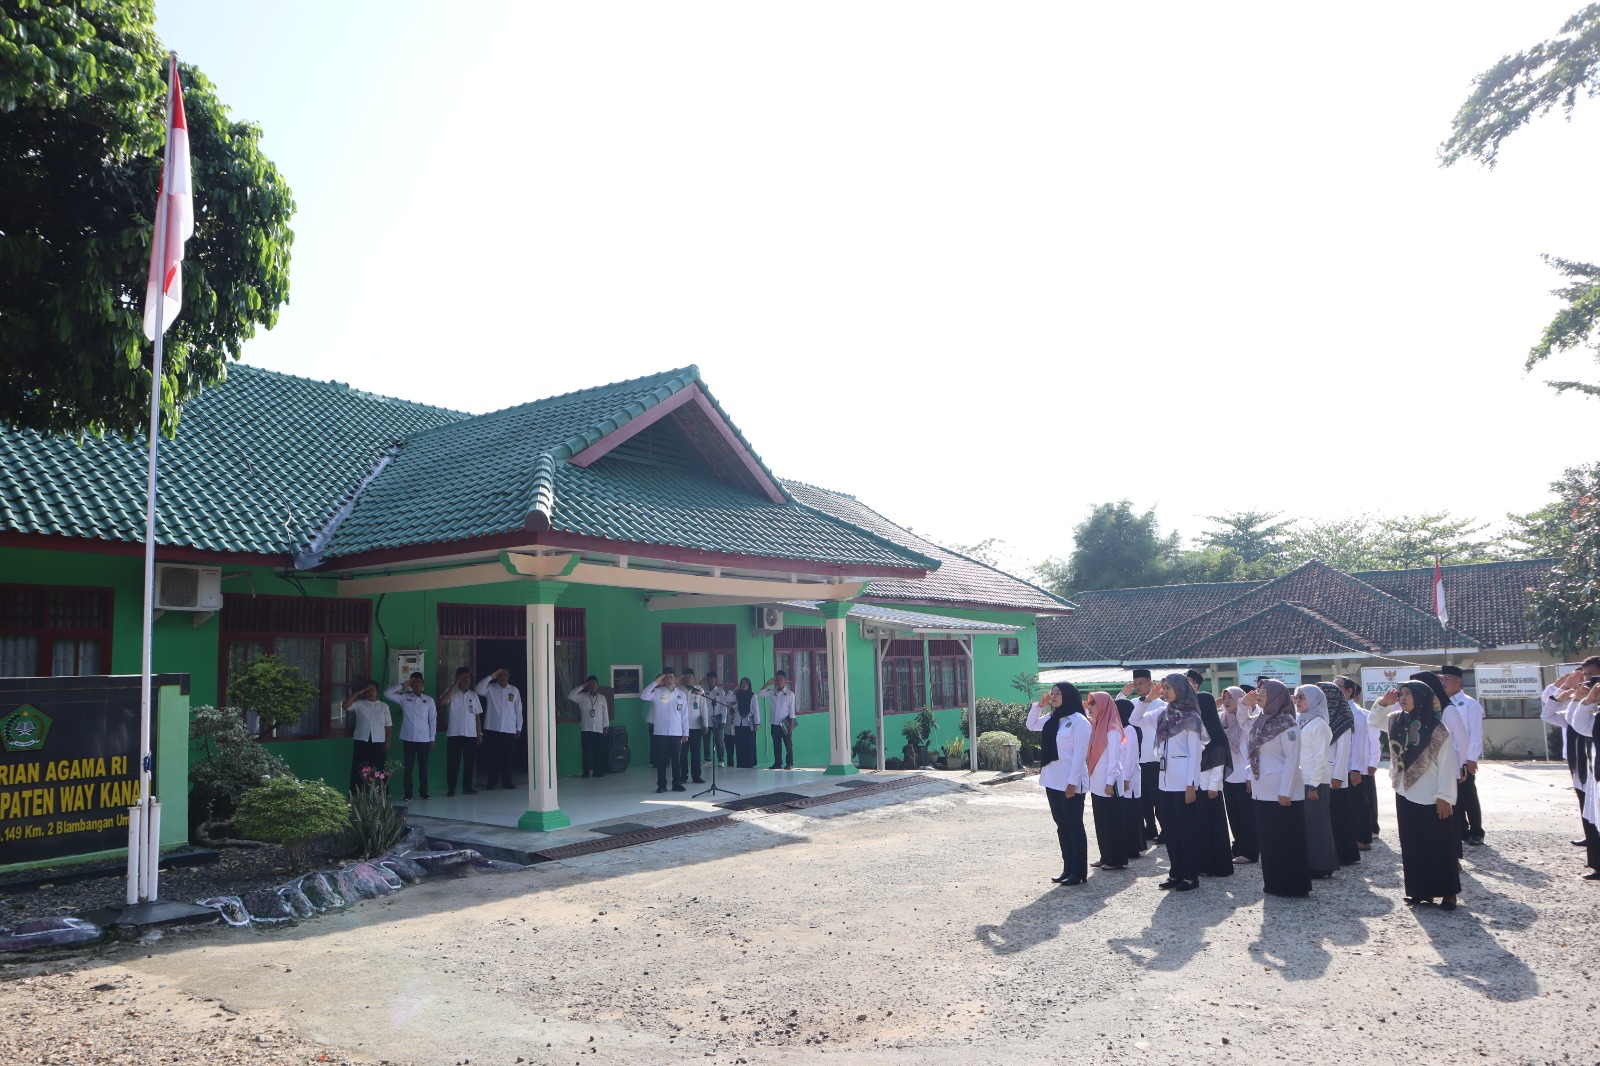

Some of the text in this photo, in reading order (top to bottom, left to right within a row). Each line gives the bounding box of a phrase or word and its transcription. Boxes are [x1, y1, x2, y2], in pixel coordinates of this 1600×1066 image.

[45, 757, 106, 782] AGAMA
[111, 756, 127, 776] RI
[60, 784, 94, 813] WAY
[100, 780, 152, 808] KANA
[24, 824, 44, 839] Km.
[48, 824, 54, 836] 2
[56, 818, 114, 834] Blambangan
